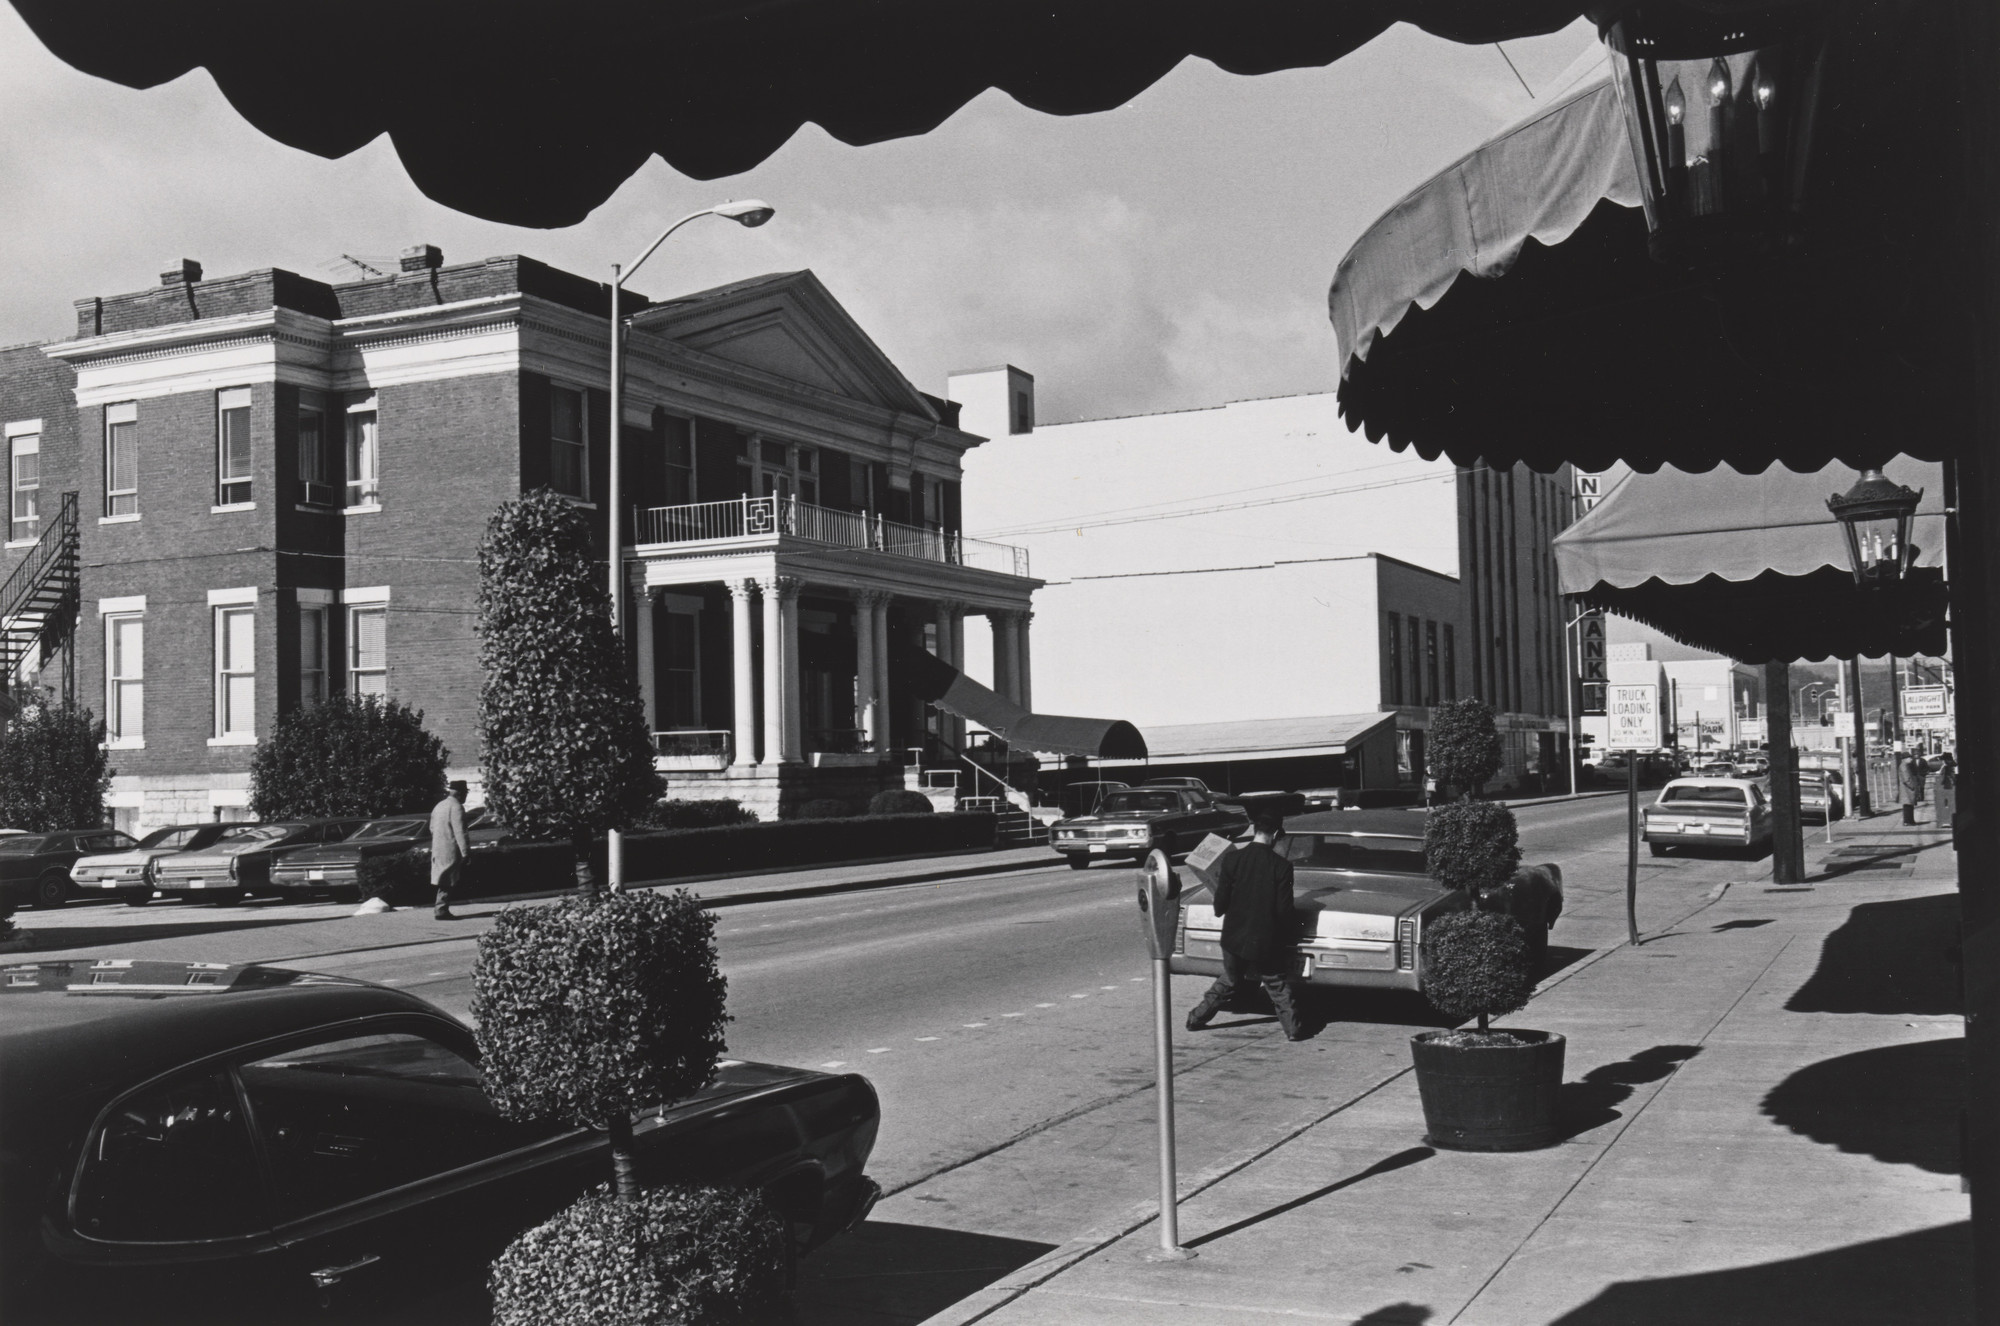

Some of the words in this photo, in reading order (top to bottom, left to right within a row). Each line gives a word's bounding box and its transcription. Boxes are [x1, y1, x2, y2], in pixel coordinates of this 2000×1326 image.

[1617, 689, 1647, 701] TRUCK
[1907, 694, 1941, 704] ALLRIGHT
[1612, 702, 1652, 715] LOADING
[1620, 716, 1644, 728] ONLY
[1702, 724, 1725, 734] PARK
[1630, 736, 1654, 744] LOADING
